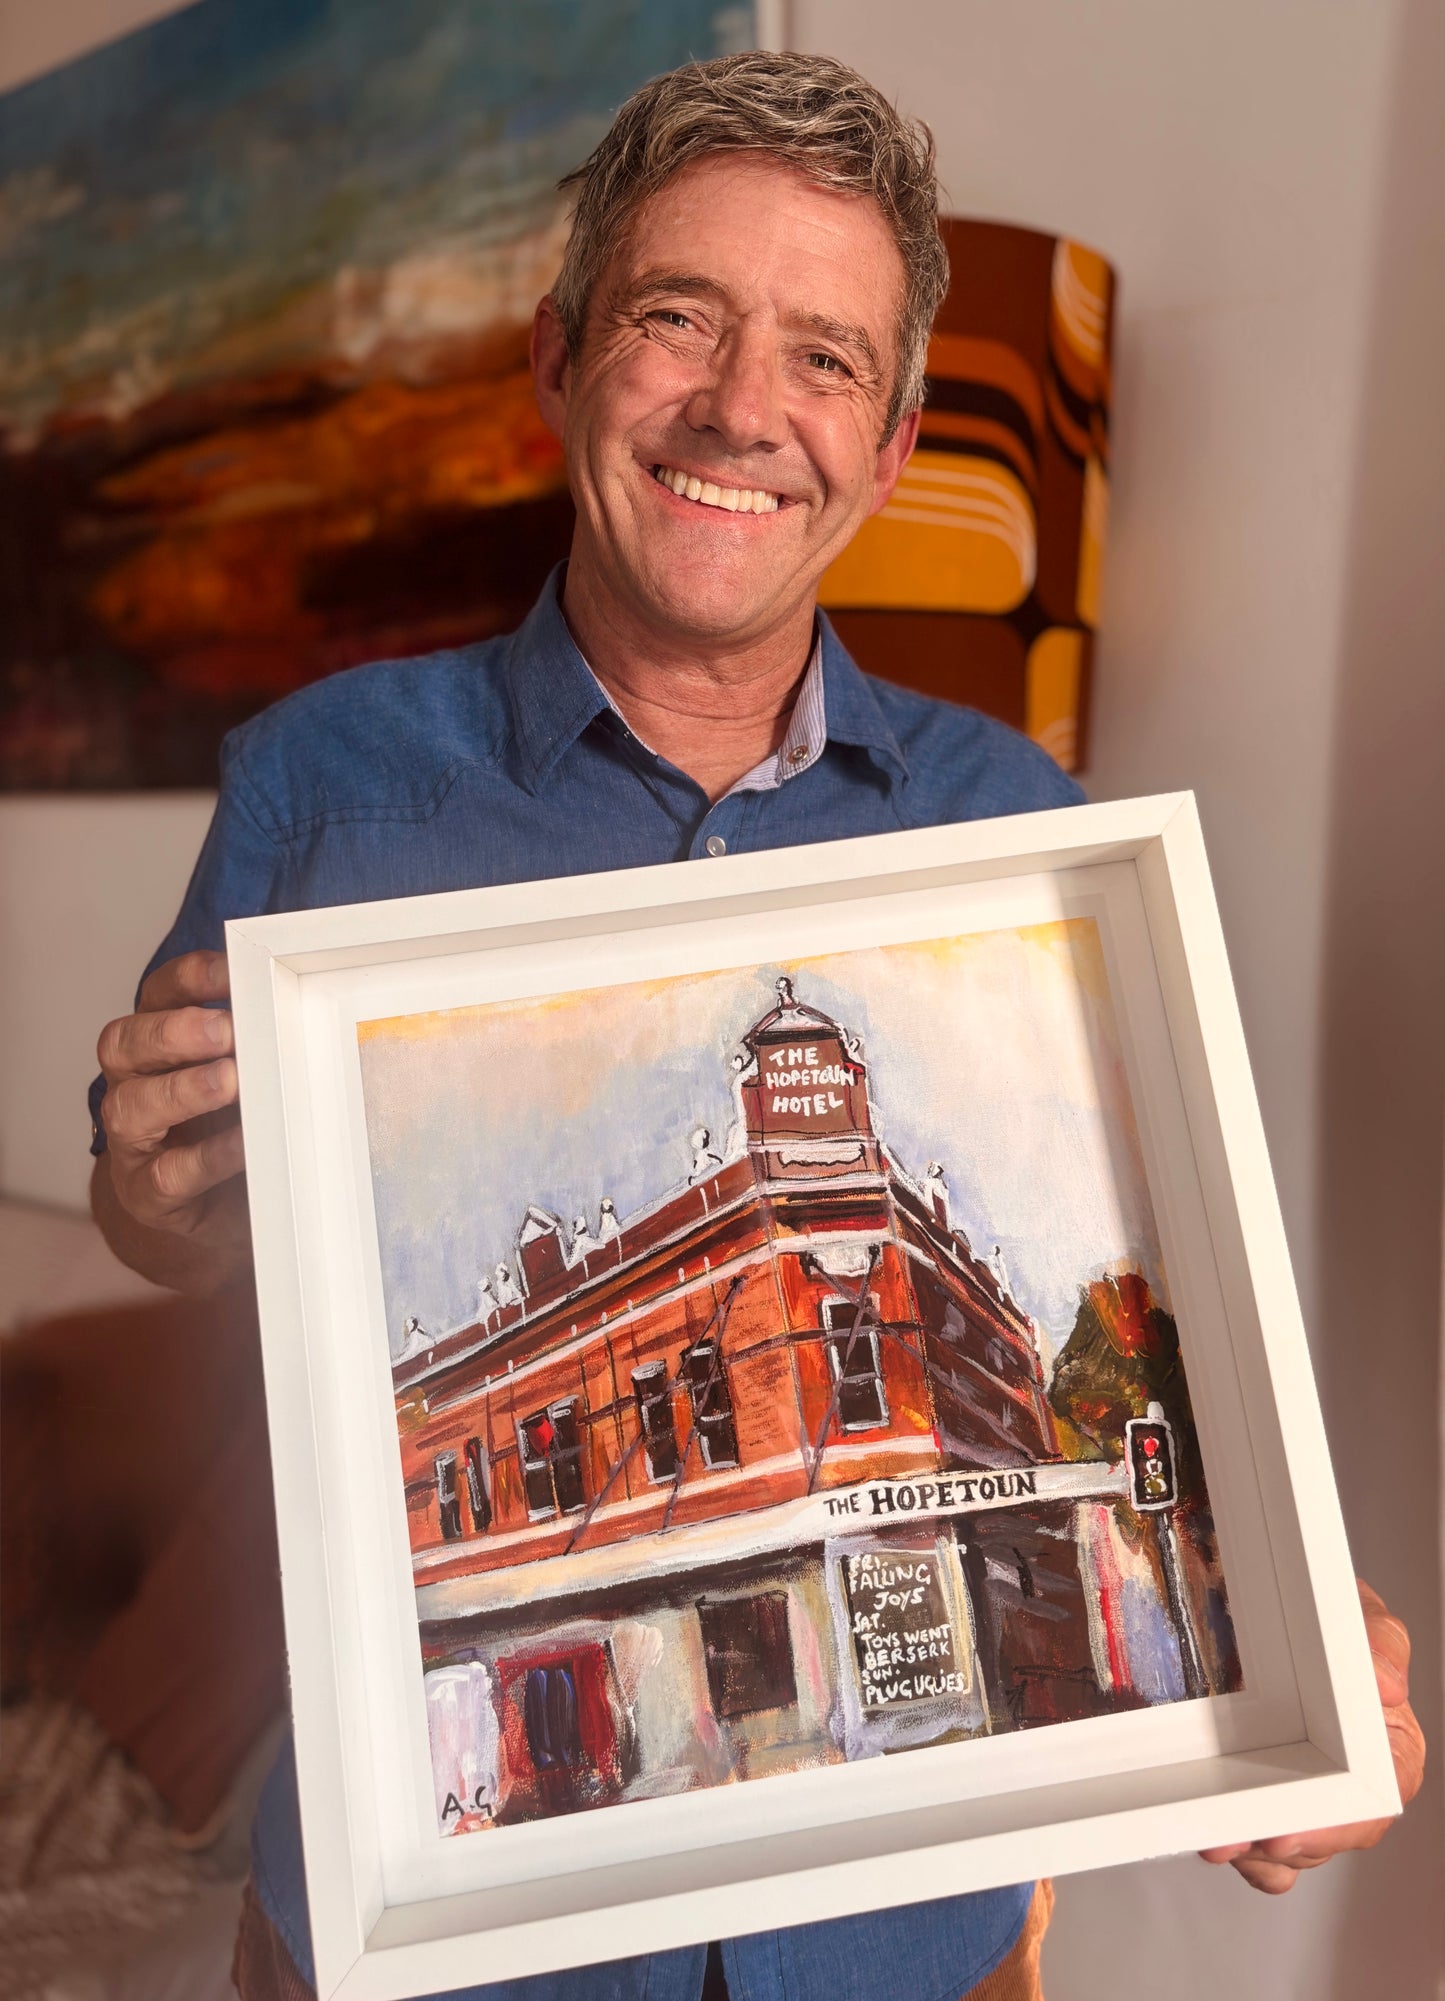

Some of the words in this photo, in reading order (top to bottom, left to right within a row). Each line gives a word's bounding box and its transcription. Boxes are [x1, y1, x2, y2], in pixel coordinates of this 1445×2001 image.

[768, 1046, 819, 1067] THE
[765, 1064, 855, 1089] HOPETOUN
[772, 1091, 844, 1117] HOTEL
[823, 1493, 861, 1517] THE
[868, 1470, 1038, 1516] HOPETOUN
[848, 1554, 889, 1572] FRI.
[873, 1587, 926, 1611] JOYS
[852, 1611, 886, 1634] SAT.
[860, 1632, 900, 1652] TOYS
[903, 1624, 951, 1645] WENT
[865, 1641, 951, 1670] BERSERK
[862, 1665, 901, 1685] SUN.
